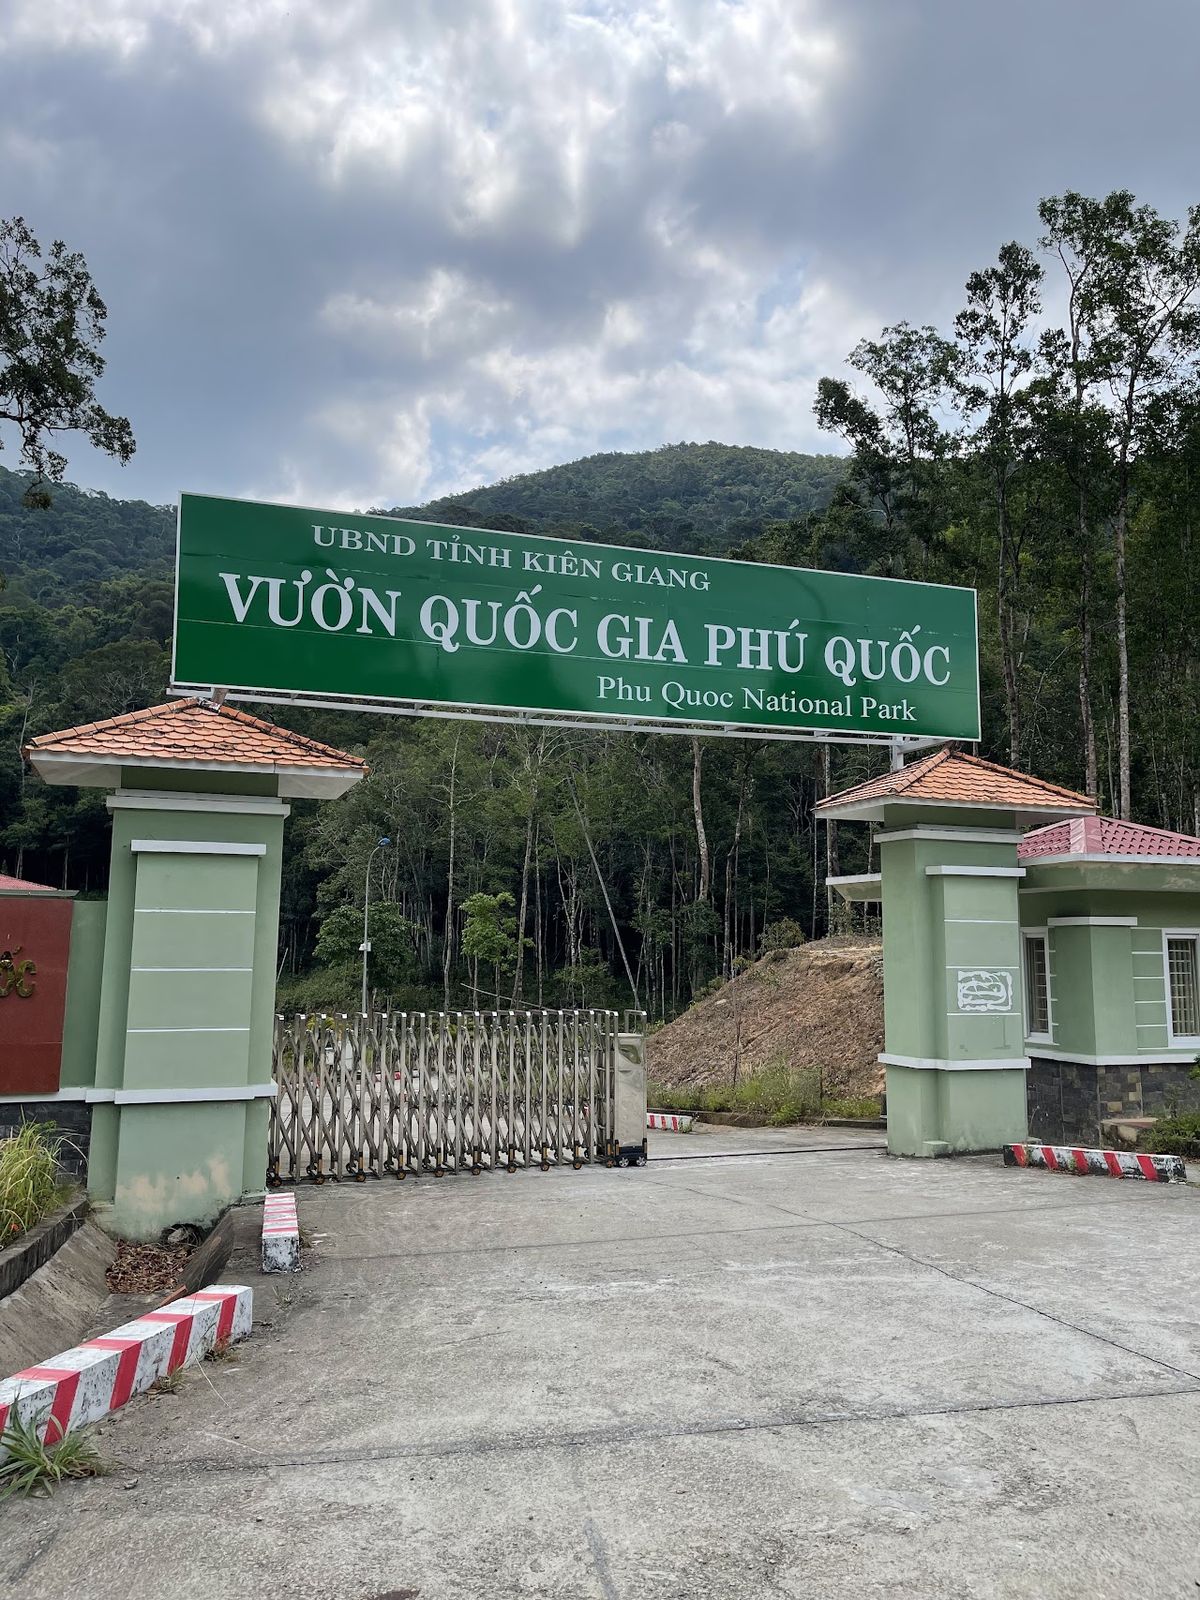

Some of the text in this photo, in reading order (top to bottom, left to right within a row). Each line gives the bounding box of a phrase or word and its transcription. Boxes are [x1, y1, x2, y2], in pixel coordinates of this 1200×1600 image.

[313, 525, 711, 592] UBND TỈNH KIÊN GIANG
[218, 568, 951, 688] VƯỜN QUỐC GIA PHÚ QUỐC
[597, 676, 917, 722] Phu Quoc National Park
